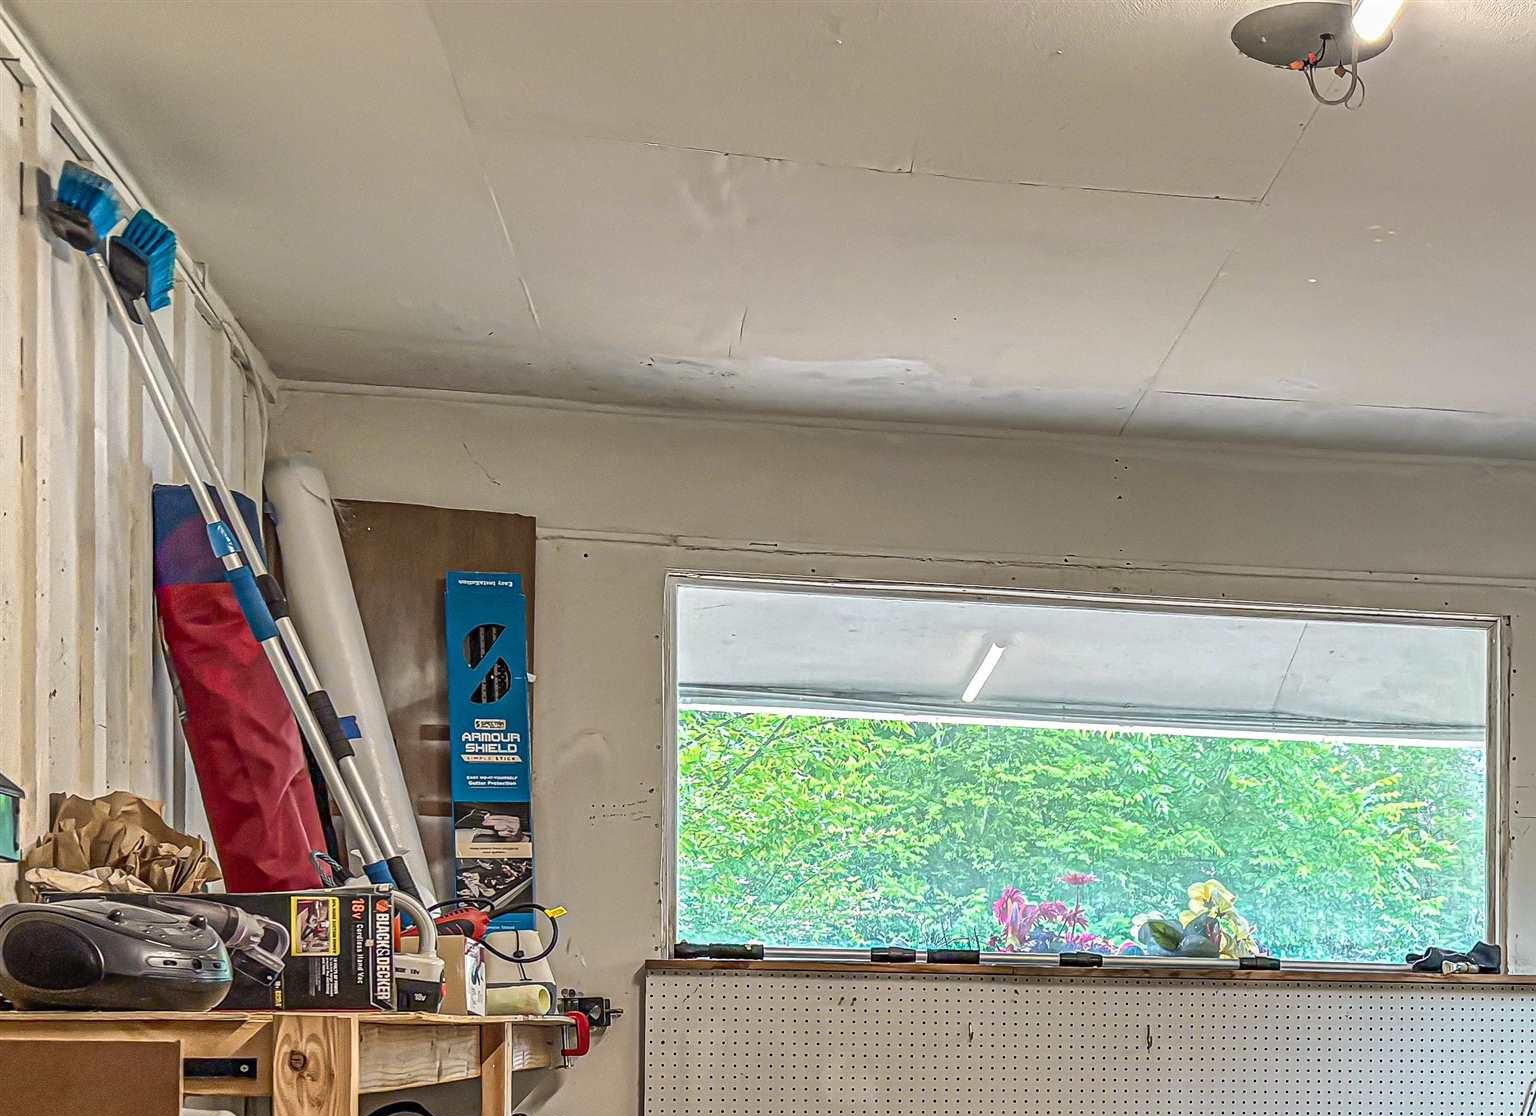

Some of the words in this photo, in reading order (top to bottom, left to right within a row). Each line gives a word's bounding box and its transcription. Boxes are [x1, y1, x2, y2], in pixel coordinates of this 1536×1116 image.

[461, 732, 521, 743] ARMOUR
[465, 743, 518, 753] SHIELD
[356, 923, 364, 953] Cordless
[356, 954, 364, 971] Hand
[375, 913, 391, 1001] BLACK&DECKER
[356, 972, 364, 985] Vac
